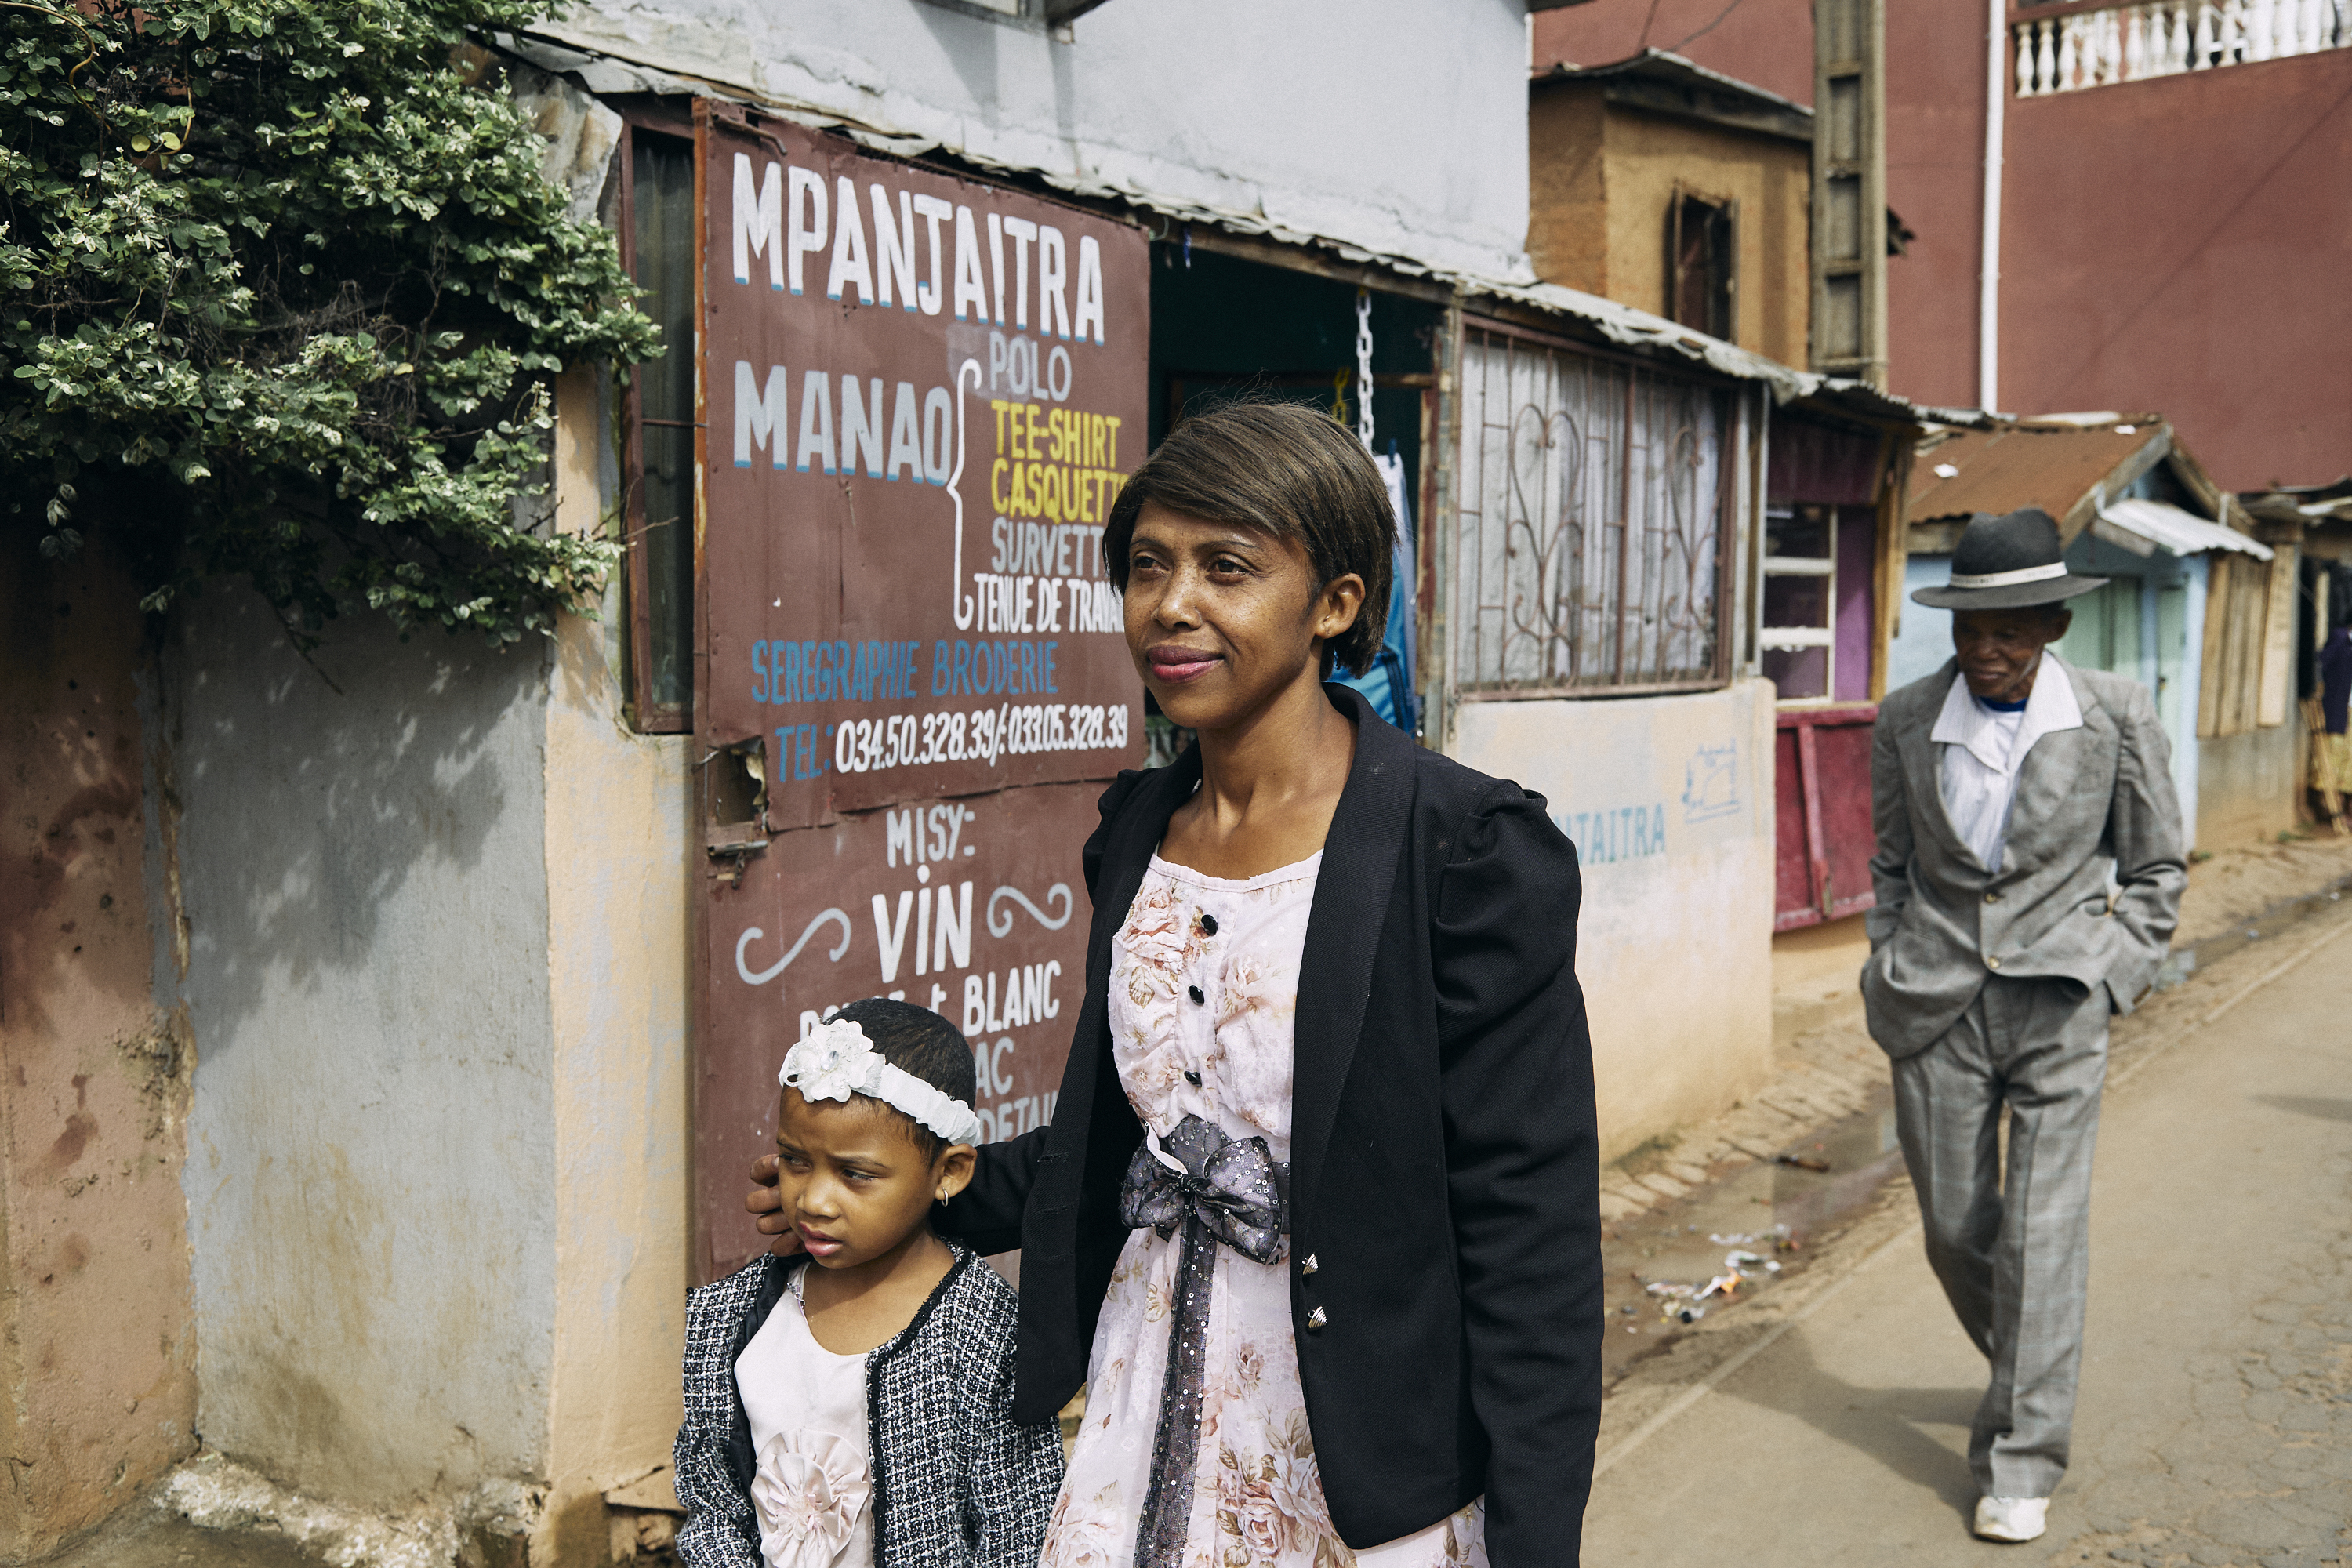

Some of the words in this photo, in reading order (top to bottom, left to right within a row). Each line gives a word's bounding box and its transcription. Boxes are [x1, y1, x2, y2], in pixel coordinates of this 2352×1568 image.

[732, 152, 1105, 346] MPANJAITRA
[989, 330, 1073, 402] POLO
[734, 360, 953, 487] MANAO
[991, 399, 1122, 469] TEE-SHIRT
[991, 457, 1130, 524] CASQUETT
[974, 572, 1035, 634] TENUE
[1036, 576, 1064, 633] DE
[751, 639, 920, 705] SEREGRAPHIE
[931, 639, 1059, 697] BRODERIE
[775, 723, 834, 782] TEL:
[887, 804, 976, 867] MISY:
[962, 959, 1062, 1037] BLANC
